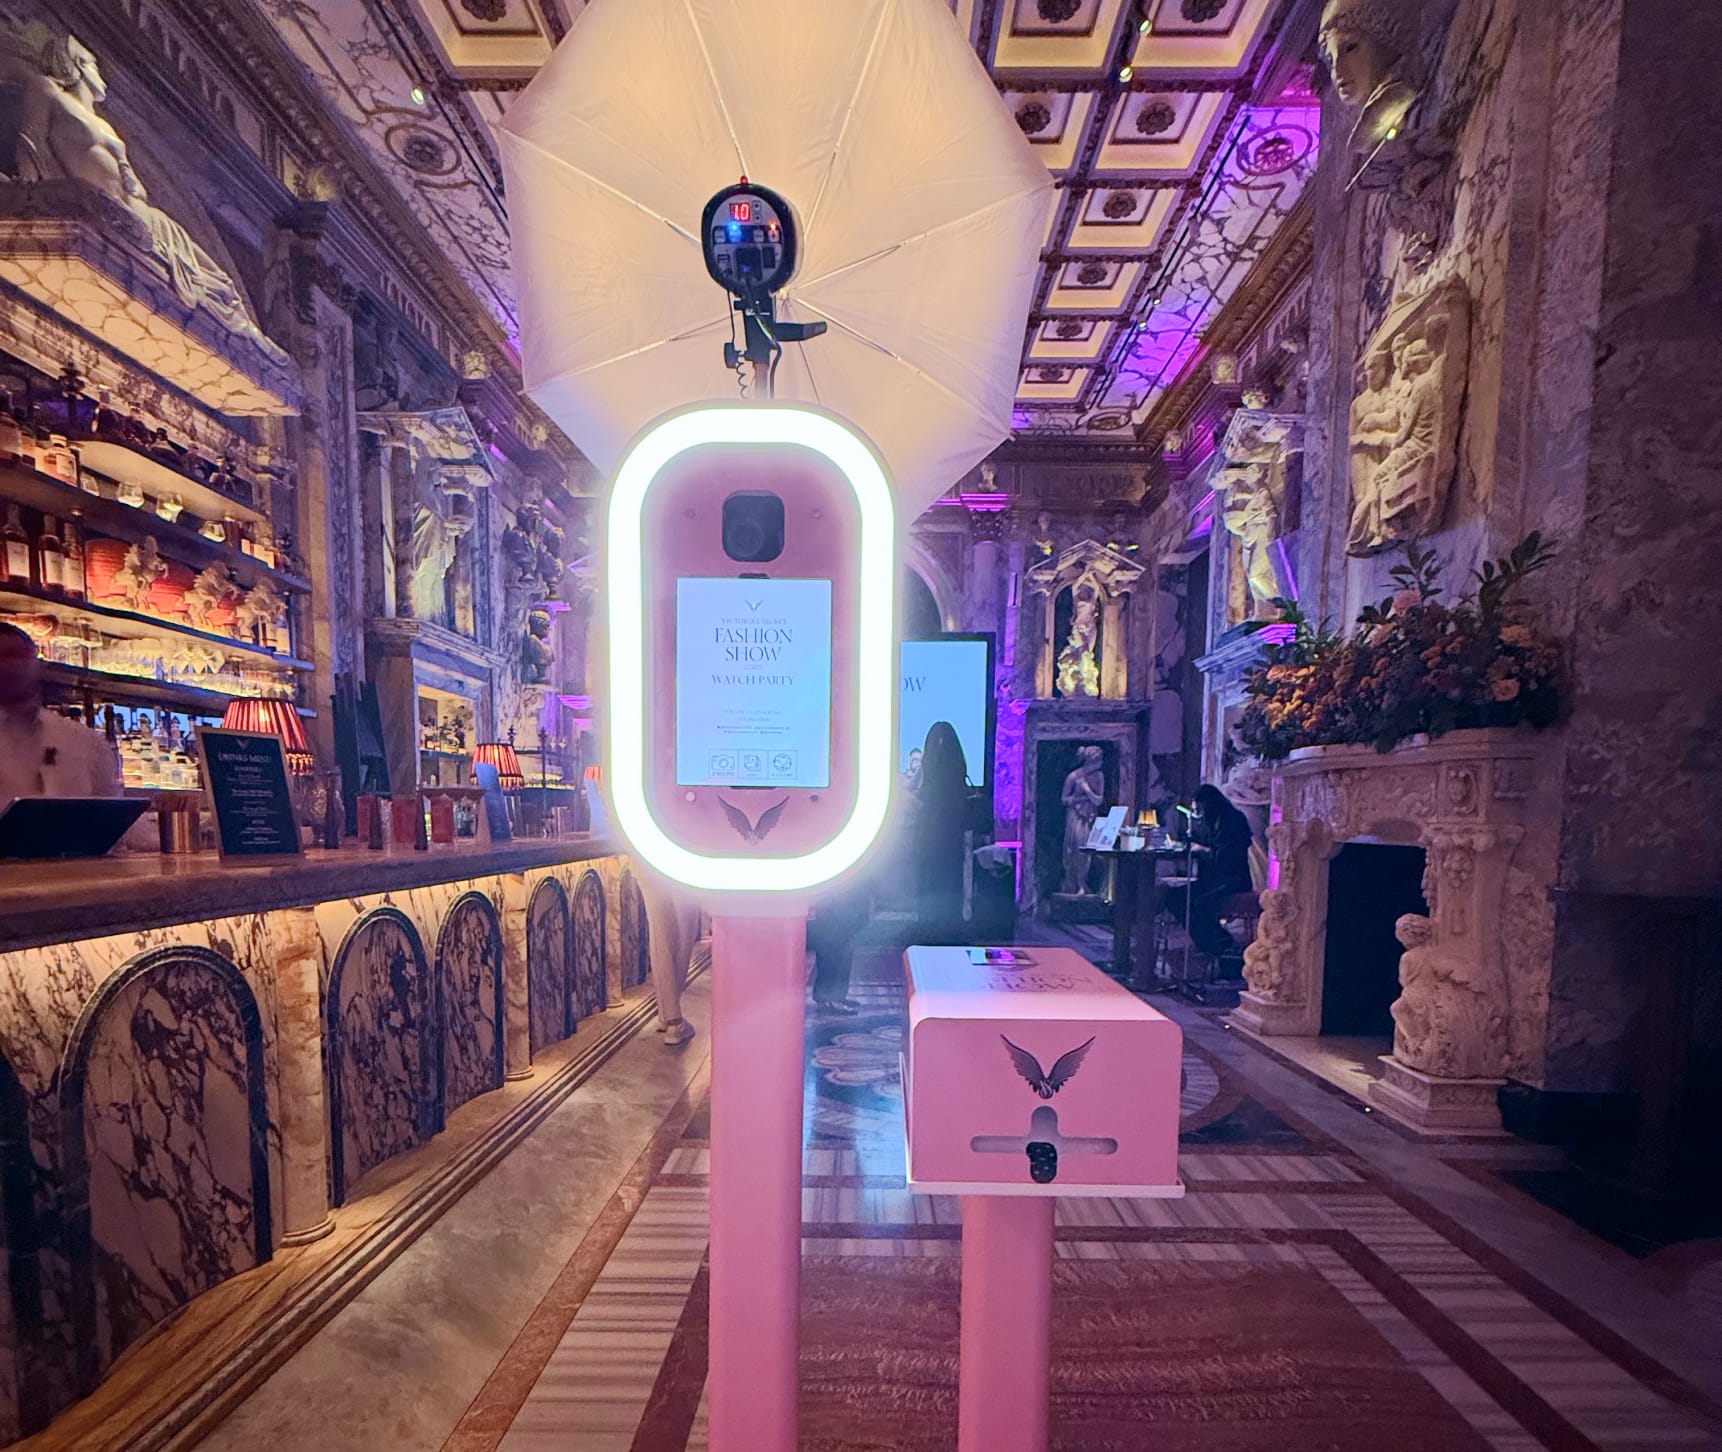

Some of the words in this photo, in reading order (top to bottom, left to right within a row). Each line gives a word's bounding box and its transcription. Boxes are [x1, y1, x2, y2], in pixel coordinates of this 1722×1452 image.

[715, 628, 793, 644] FASHION
[725, 646, 781, 661] SHOW
[711, 674, 755, 685] WATCH
[758, 675, 794, 686] PARTY
